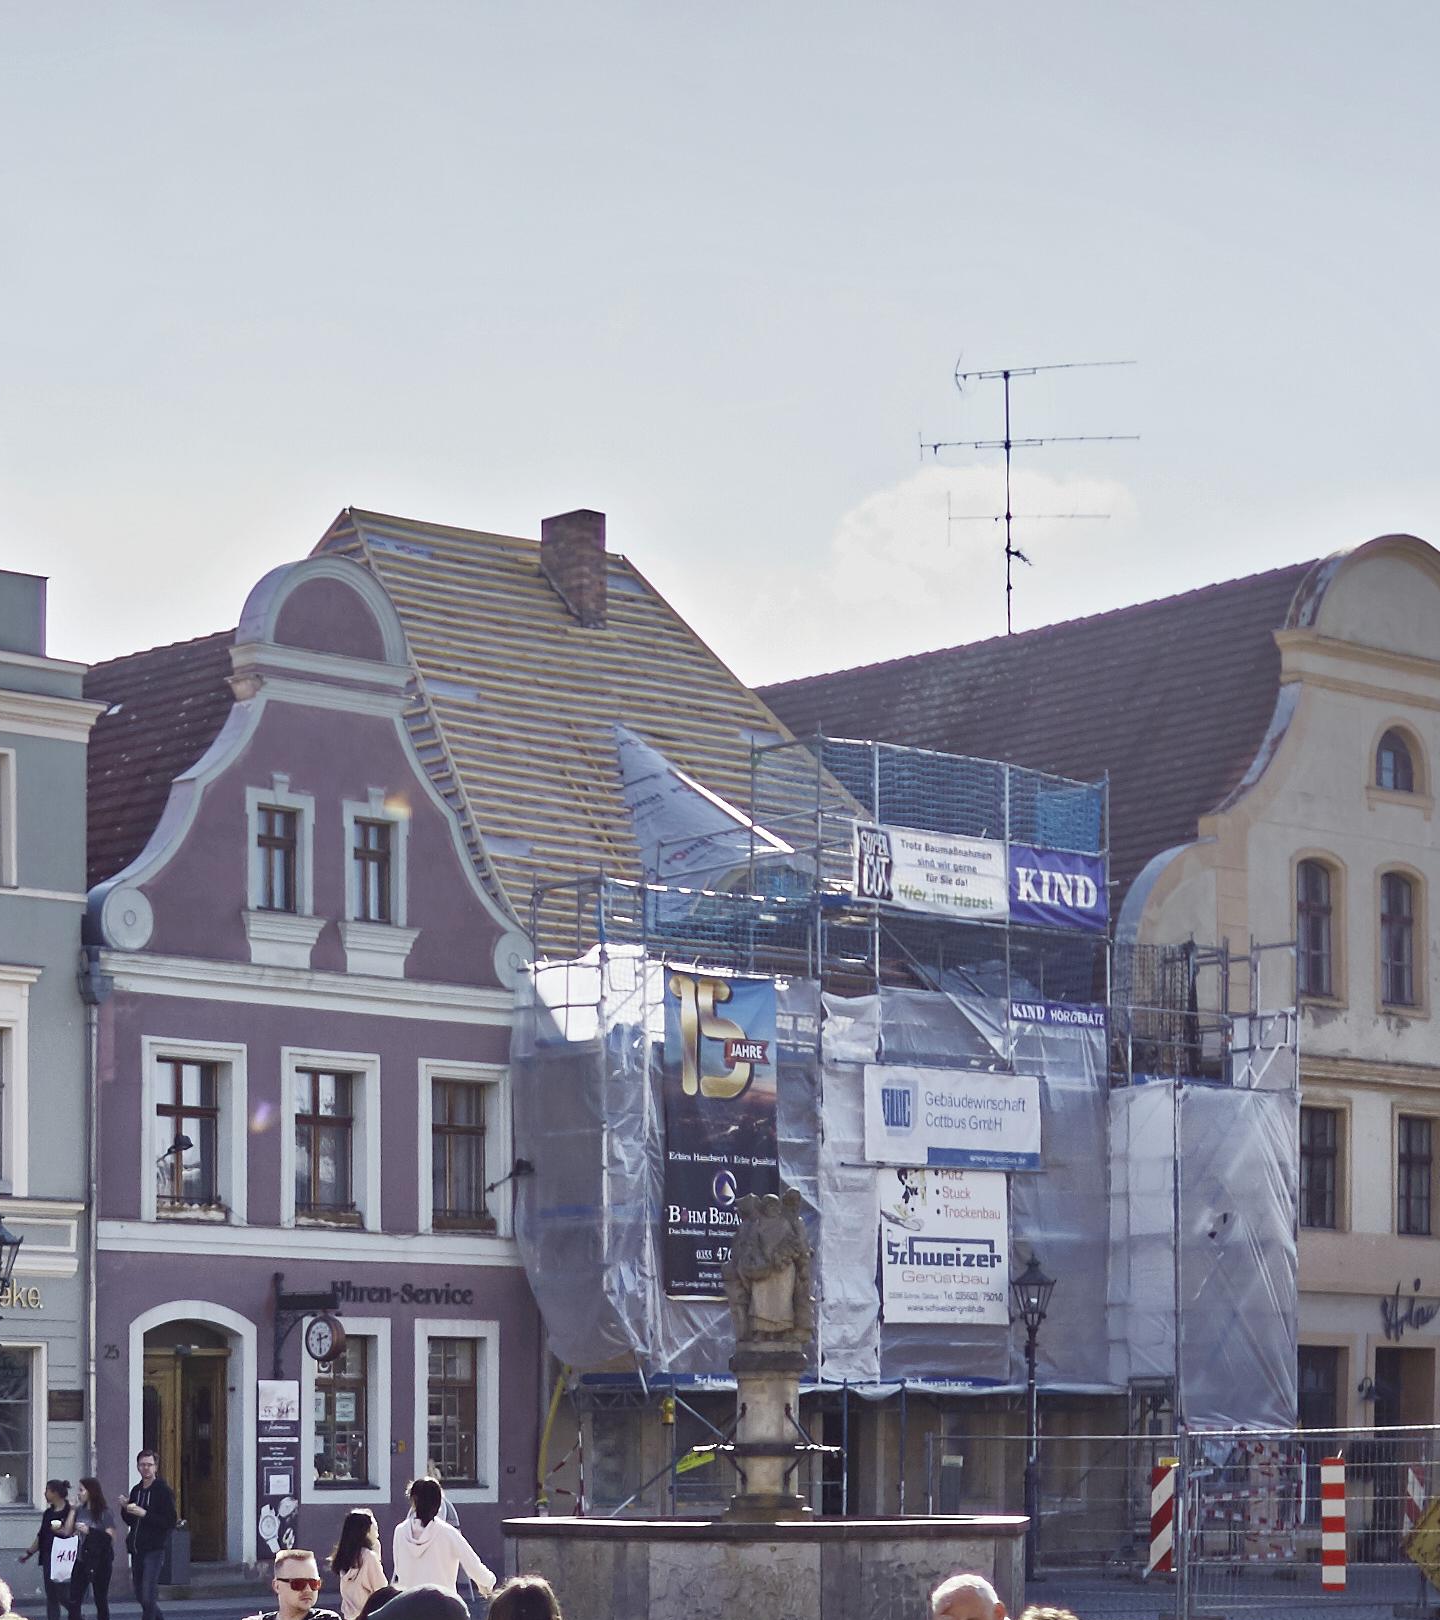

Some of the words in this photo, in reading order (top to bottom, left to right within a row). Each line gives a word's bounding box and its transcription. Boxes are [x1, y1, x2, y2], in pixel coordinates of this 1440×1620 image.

[901, 839, 922, 852] Trotz
[917, 858, 935, 869] sind
[937, 861, 951, 872] wir
[953, 863, 977, 875] gerne
[926, 873, 938, 884] für
[940, 875, 953, 885] Sie
[1015, 867, 1098, 909] KIND
[898, 884, 928, 901] Hier
[933, 889, 949, 905] im
[954, 894, 993, 910] Haus!
[1012, 1003, 1046, 1020] KIND
[669, 975, 751, 1099] 15
[731, 1044, 763, 1059] JAHRE
[925, 1113, 967, 1130] Cottbus
[969, 1115, 1003, 1132] GmbH
[942, 1186, 971, 1200] Stuck
[709, 1206, 742, 1225] BEDA
[943, 1205, 1001, 1220] Trockenbau
[887, 1236, 1002, 1268] Schweizer
[902, 1270, 990, 1285] Gerüstbau
[103, 1343, 120, 1360] 25
